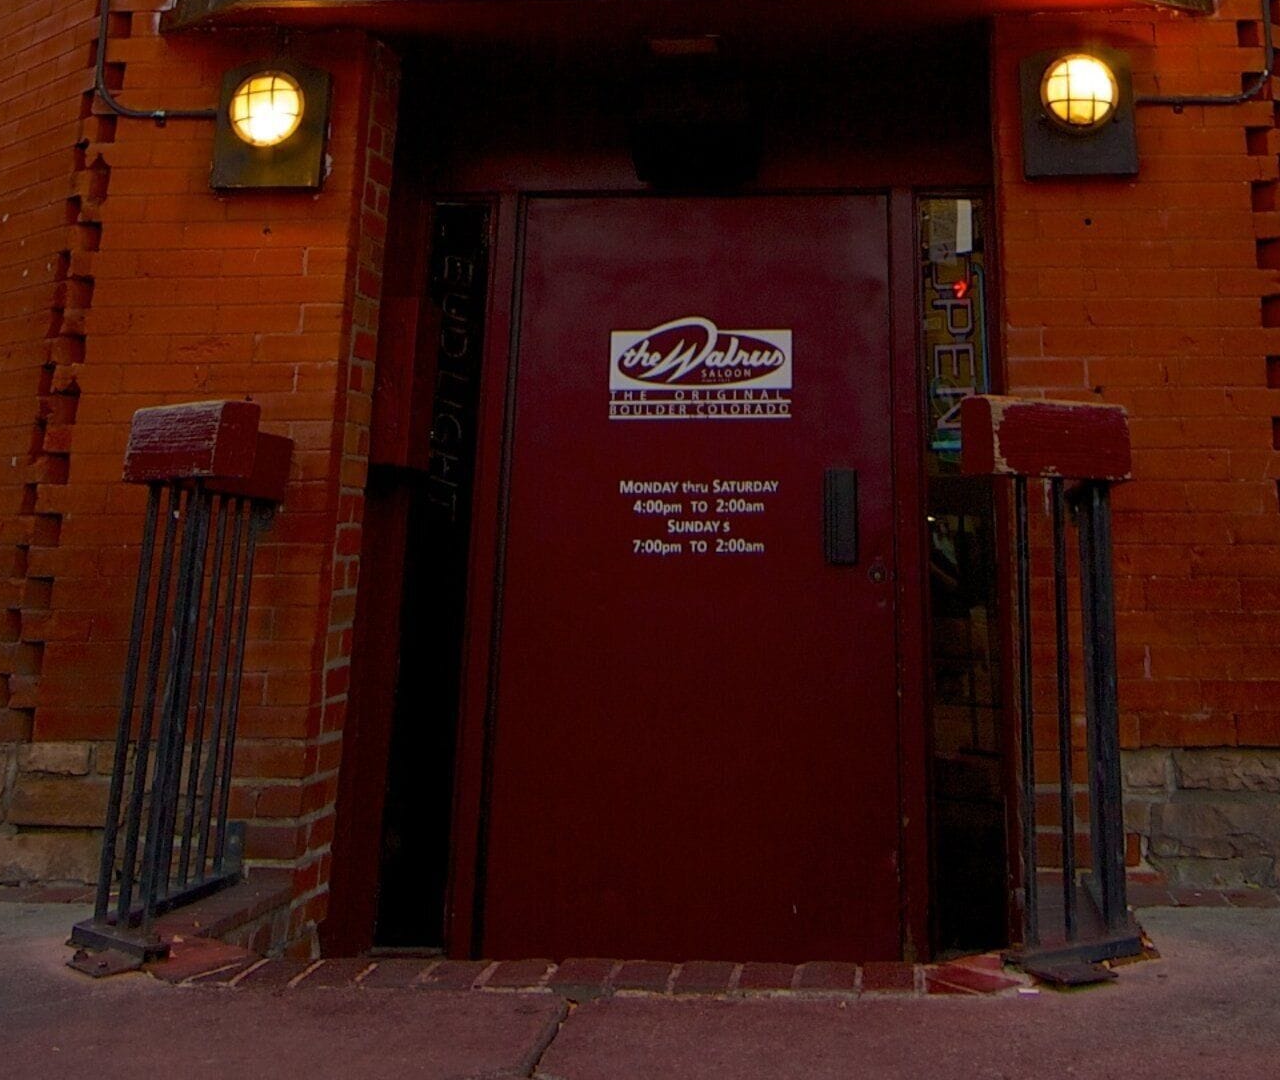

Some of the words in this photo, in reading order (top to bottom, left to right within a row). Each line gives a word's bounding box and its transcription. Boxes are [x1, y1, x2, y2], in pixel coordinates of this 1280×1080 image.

[623, 339, 662, 367] the
[637, 316, 784, 383] Walrus
[701, 368, 752, 378] SALOON
[610, 390, 648, 400] THE
[674, 390, 783, 400] ORIGINAL
[610, 404, 687, 415] BOULDER
[696, 404, 789, 415] COLORADO
[620, 480, 678, 493] MONDAY
[682, 481, 708, 493] thru
[713, 480, 779, 493] SATURDAY
[633, 499, 682, 515] 4:00pm
[690, 501, 708, 512] TO
[716, 499, 764, 512] 2:00am
[667, 520, 720, 532] SUNDAY
[632, 540, 681, 555] 7:00pm
[690, 541, 707, 552] TO
[715, 539, 764, 552] 2:00am
